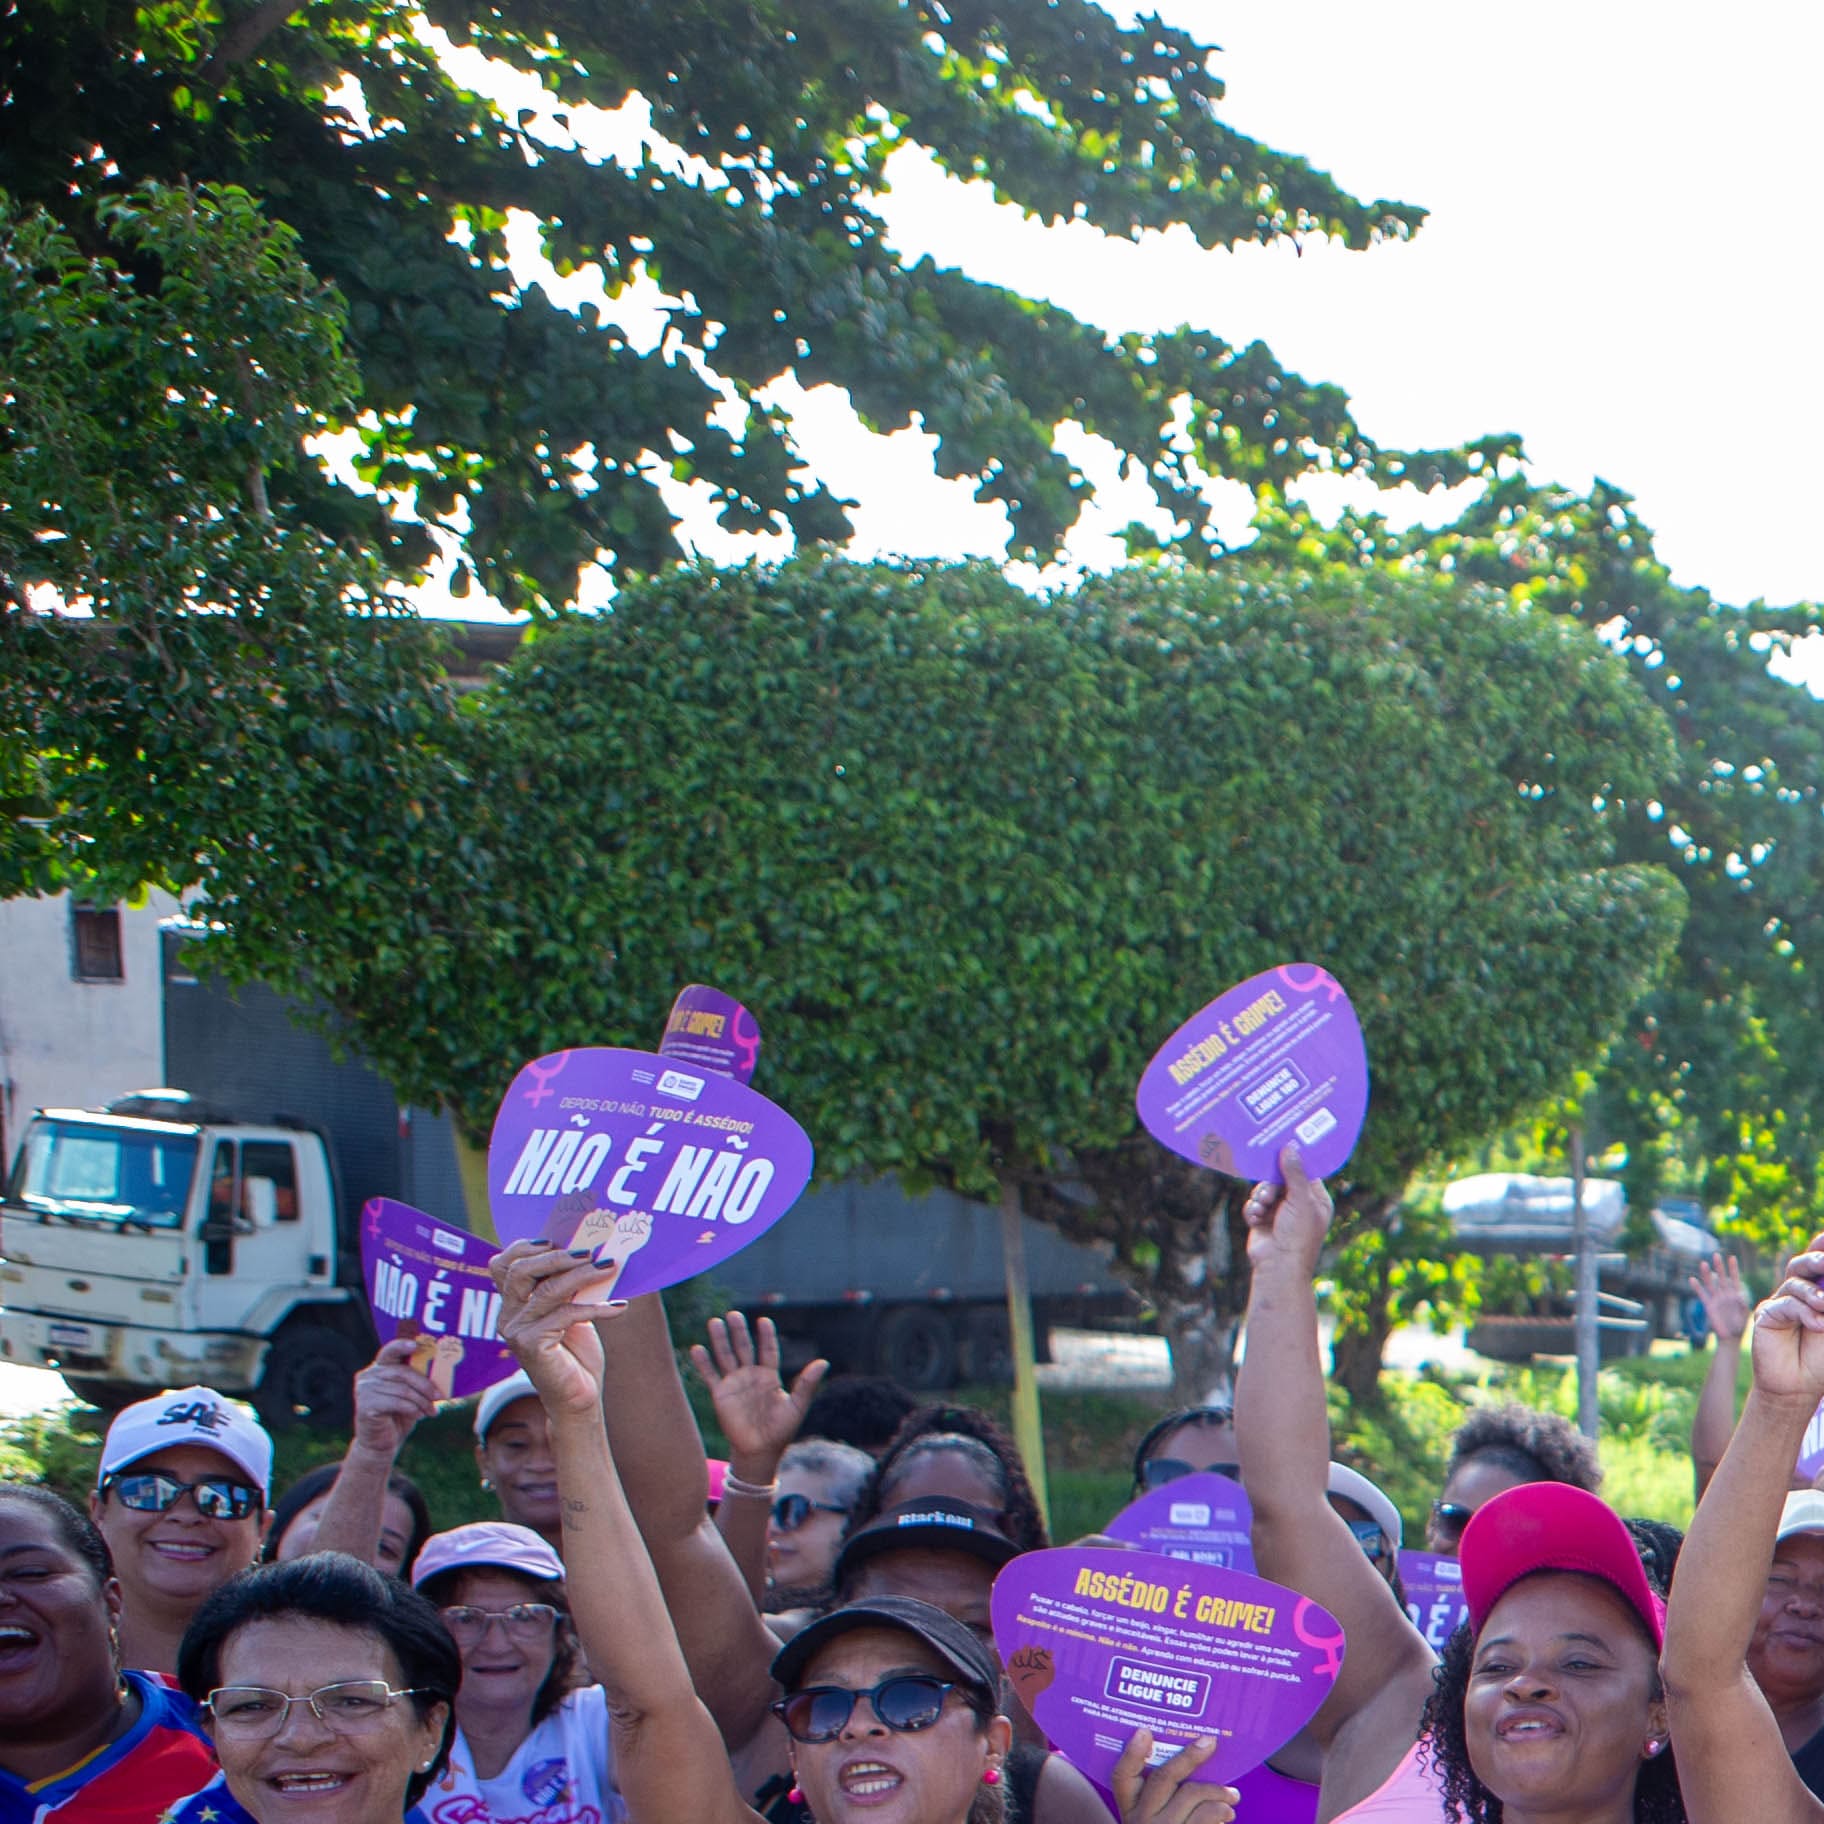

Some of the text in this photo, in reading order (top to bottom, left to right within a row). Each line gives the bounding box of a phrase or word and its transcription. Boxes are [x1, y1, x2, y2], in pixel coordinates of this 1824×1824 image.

[1168, 1034, 1228, 1085] ASSÉDIO
[559, 1097, 754, 1135] DEPOIS DO TUDO ASSÉDIO!
[503, 1114, 775, 1224] NÃO É NÃO
[374, 1253, 452, 1332] NÃO É
[1074, 1567, 1276, 1634] ASSÉDIO É CRIME!
[1118, 1681, 1193, 1707] LIGUE 180
[1120, 1666, 1198, 1693] DENUNCIE
